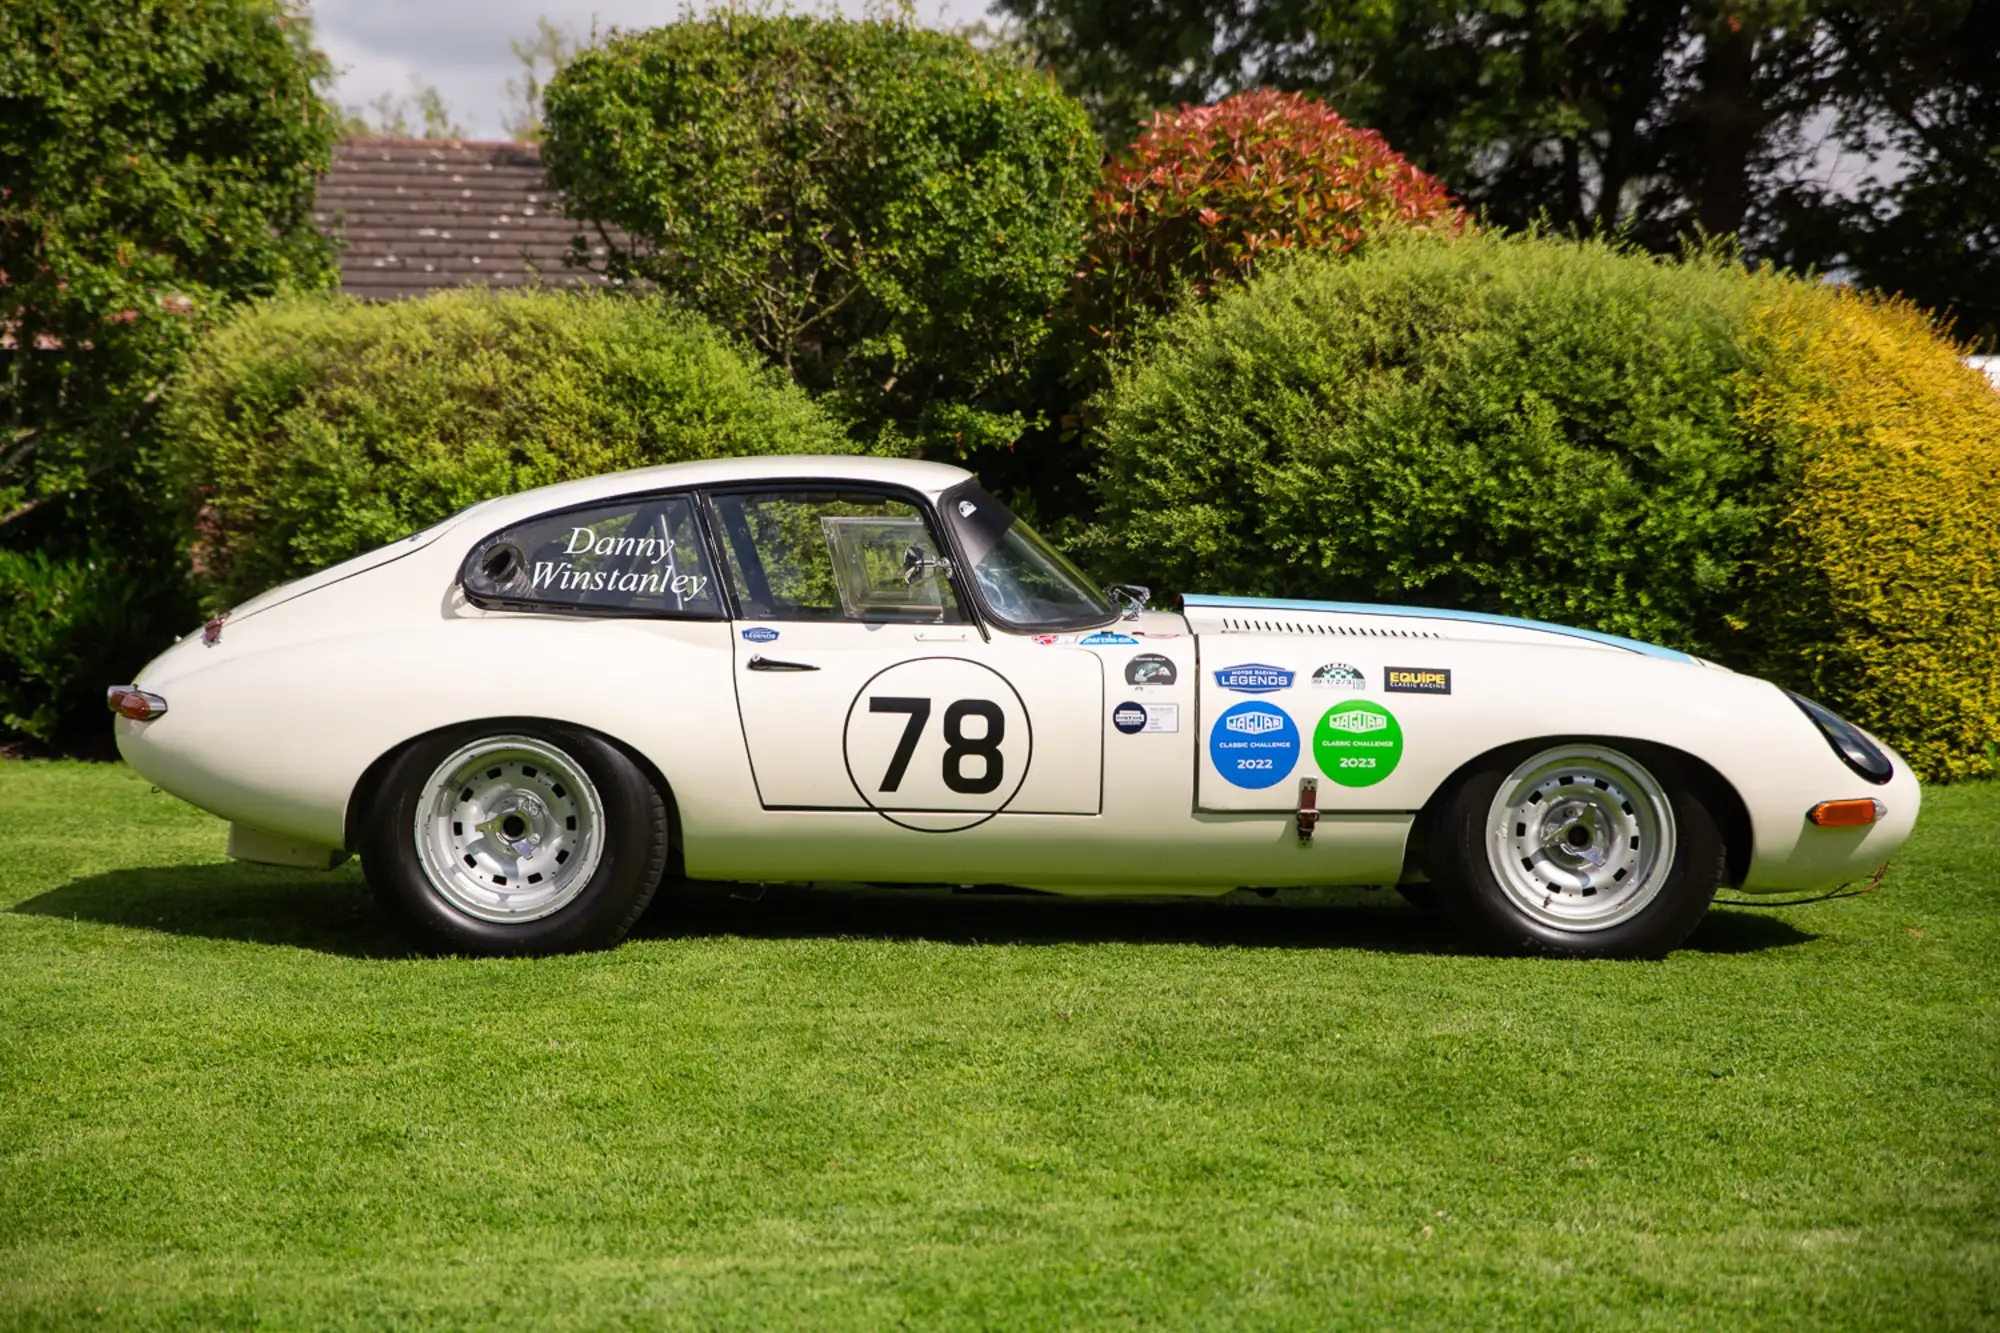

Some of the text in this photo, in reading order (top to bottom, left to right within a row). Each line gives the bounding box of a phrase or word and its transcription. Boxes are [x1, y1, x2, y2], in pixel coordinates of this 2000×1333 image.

[563, 527, 676, 565] Danny
[531, 561, 708, 602] Winstanley
[1221, 675, 1289, 686] LEGENDS
[1227, 713, 1283, 733] JAGUAR
[1330, 712, 1386, 732] JAGUAR
[869, 696, 1005, 795] 78
[1237, 759, 1273, 769] 2022
[1339, 757, 1377, 769] 2023
